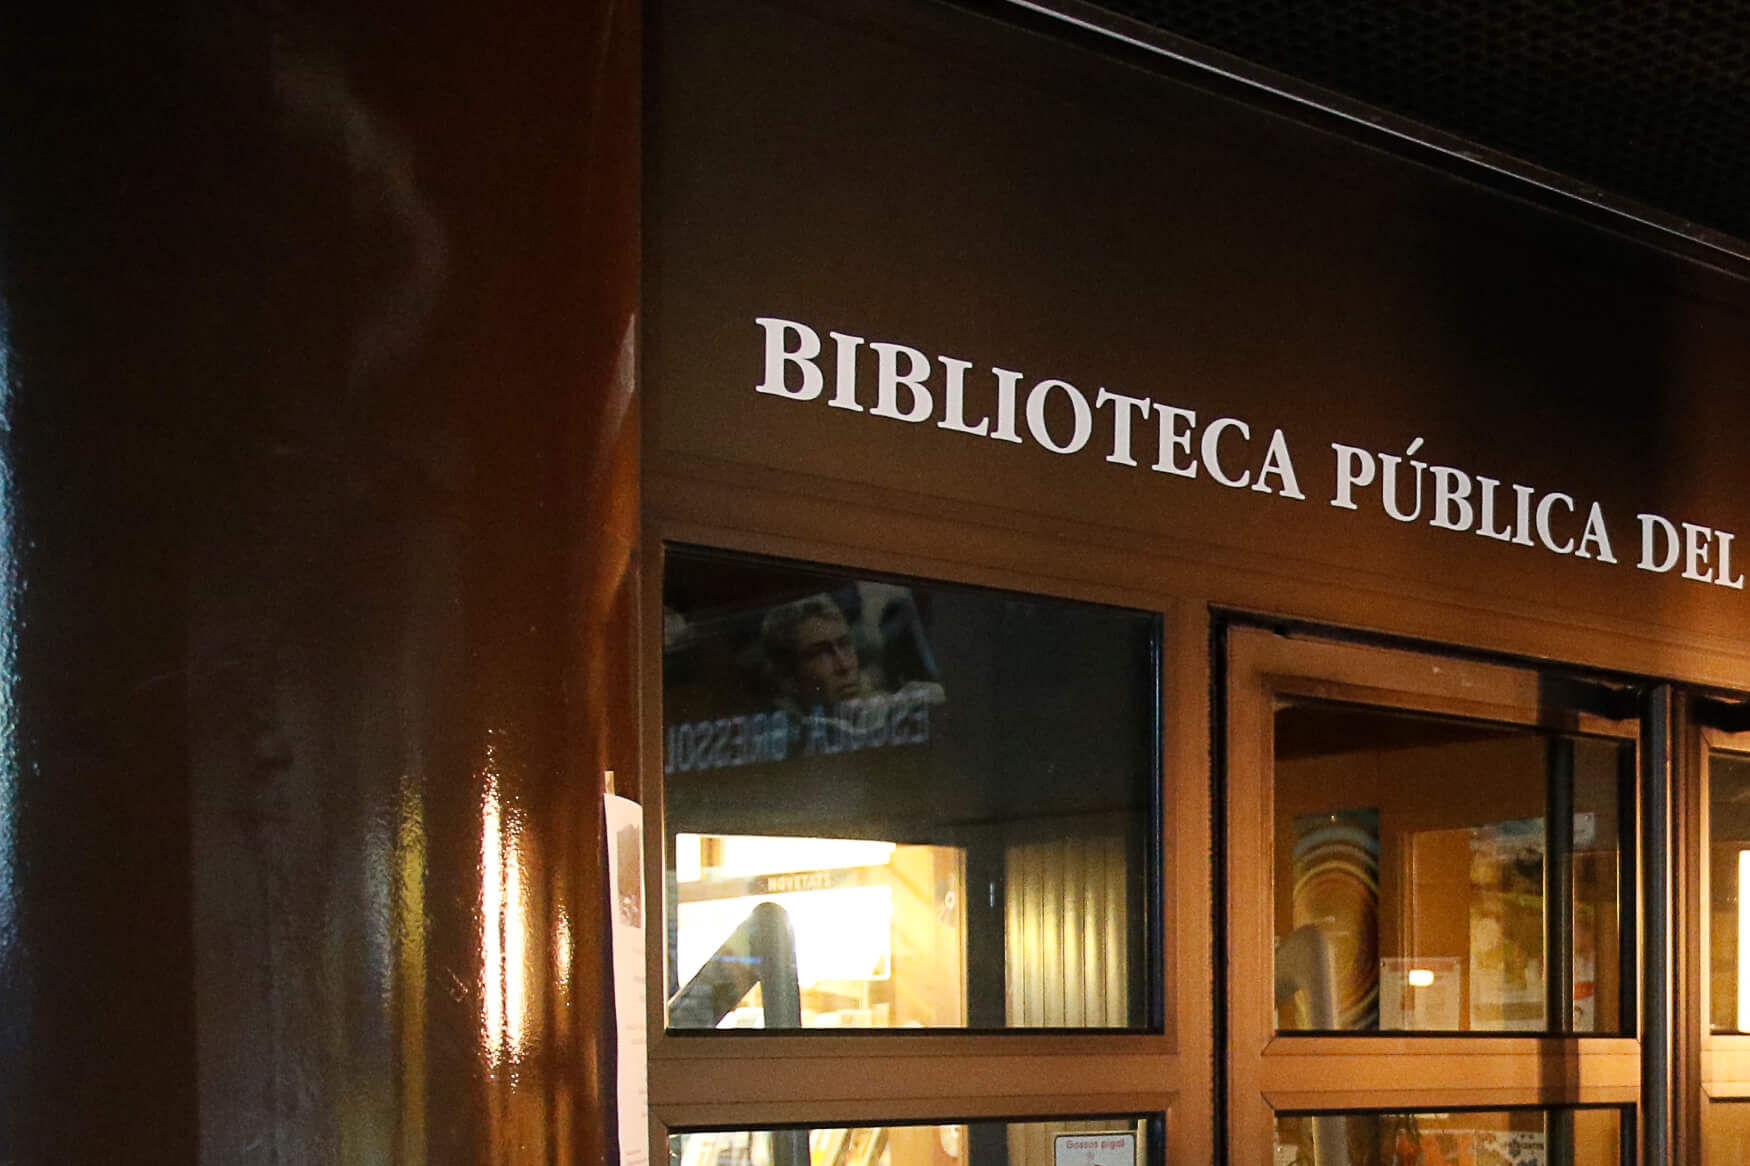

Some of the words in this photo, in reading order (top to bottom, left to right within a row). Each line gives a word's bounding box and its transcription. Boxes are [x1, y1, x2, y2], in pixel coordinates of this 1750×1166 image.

[755, 316, 1305, 500] BIBLIOTECA
[1330, 437, 1617, 564] PÚBLICA
[1637, 513, 1744, 591] DEL
[768, 873, 831, 892] NOVETATS
